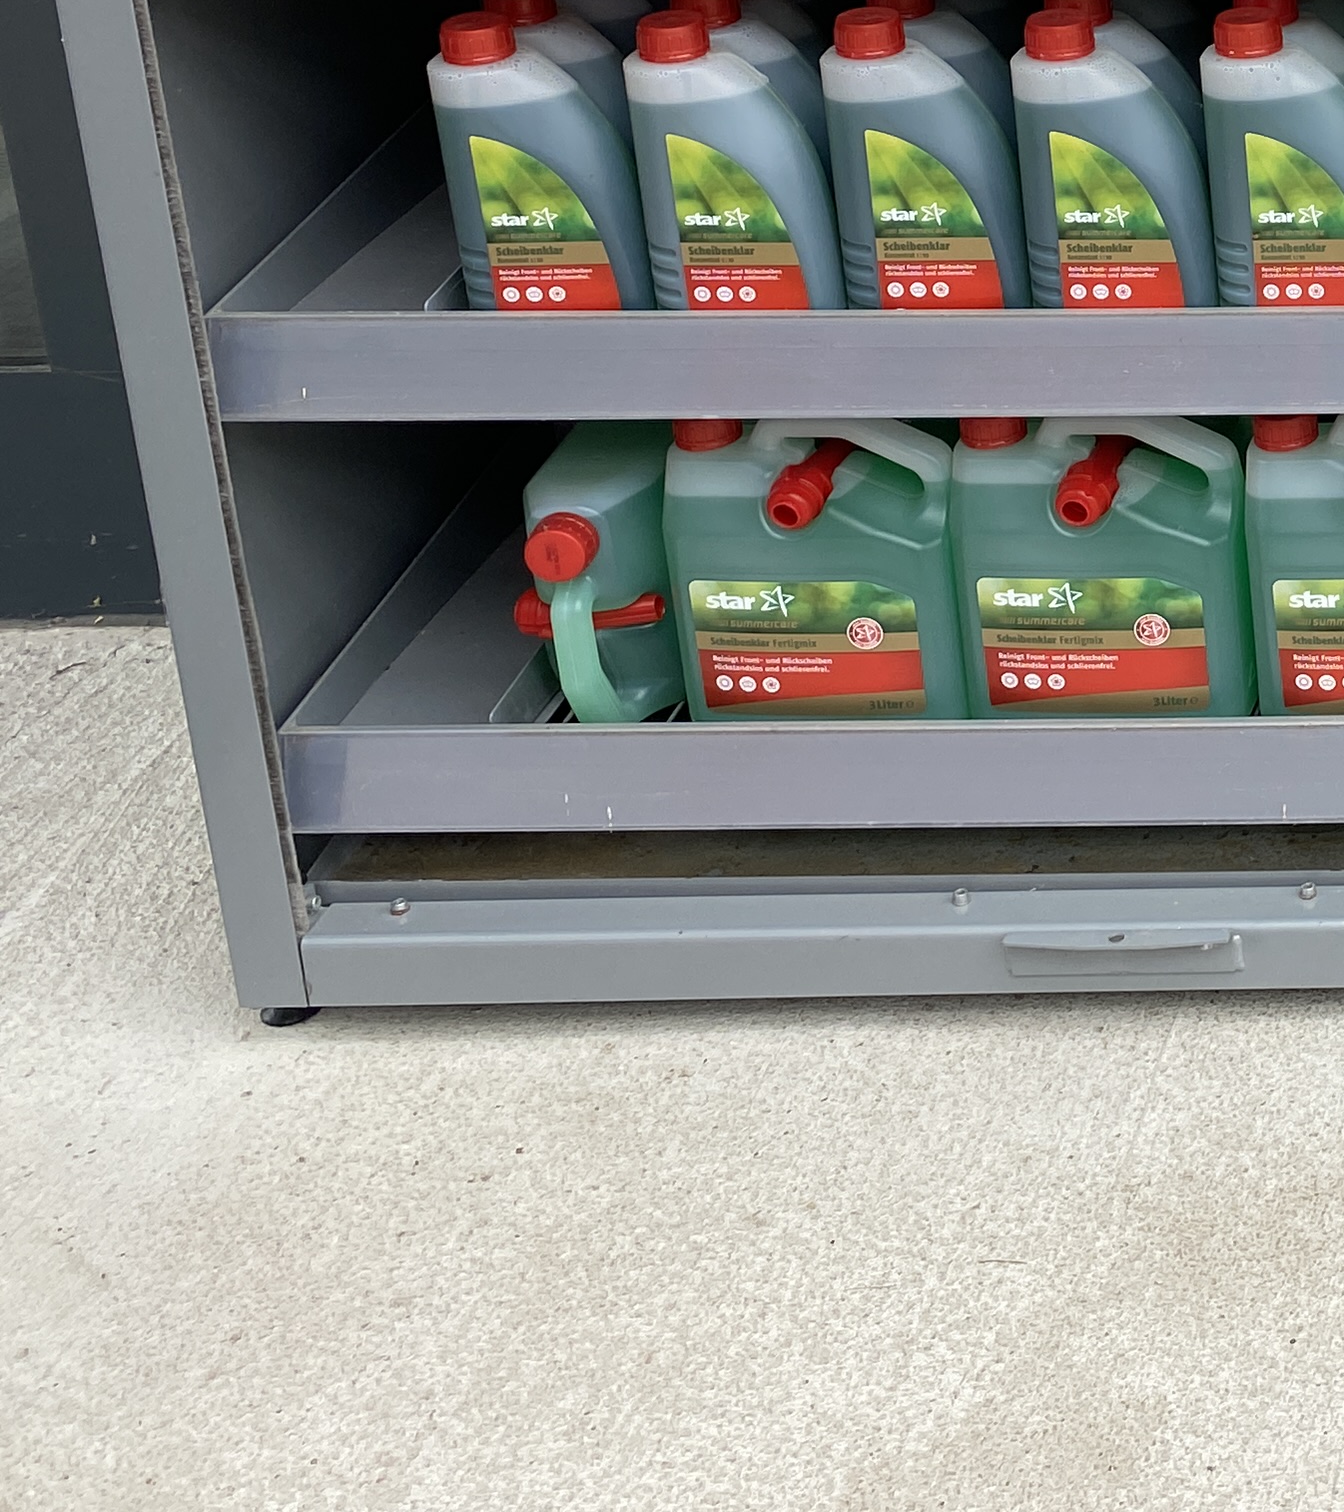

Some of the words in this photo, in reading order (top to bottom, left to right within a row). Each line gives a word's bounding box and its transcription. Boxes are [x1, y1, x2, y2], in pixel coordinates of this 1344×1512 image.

[490, 212, 529, 228] star
[684, 211, 722, 228] star
[879, 208, 918, 222] star
[1063, 209, 1101, 224] star
[1257, 209, 1295, 224] star
[882, 241, 950, 252] Scheibenklar
[1066, 243, 1133, 254] Scheibenklar
[1259, 243, 1326, 254] Scheibenklar
[705, 590, 757, 612] star
[992, 588, 1044, 609] star
[1288, 589, 1340, 609] star
